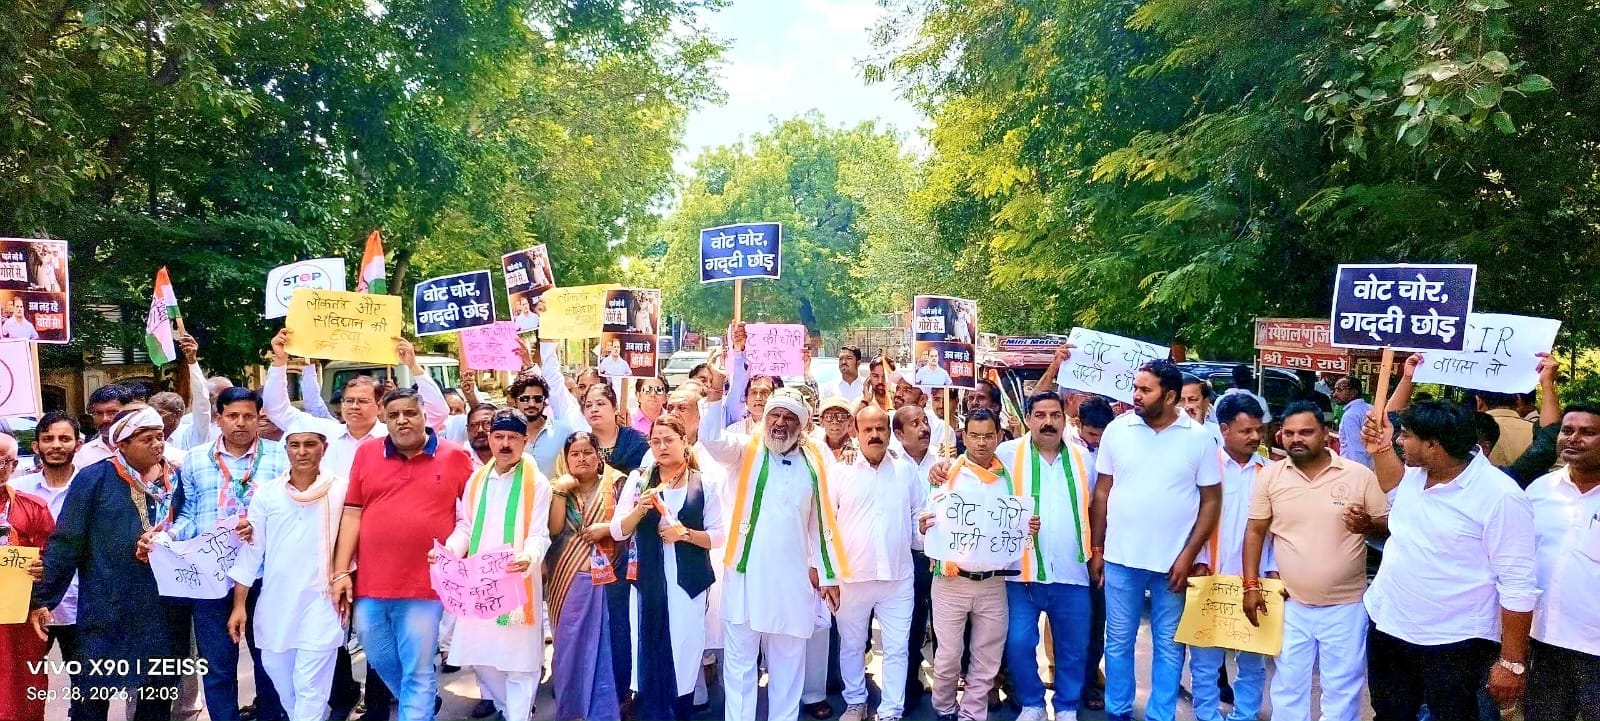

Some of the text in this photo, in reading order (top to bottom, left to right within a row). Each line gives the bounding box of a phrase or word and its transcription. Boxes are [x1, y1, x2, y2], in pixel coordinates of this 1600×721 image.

[711, 229, 768, 249] वोट चोर,
[747, 249, 775, 271] छोड़
[283, 272, 322, 286] STOP
[1353, 273, 1449, 304] वोट चोर,
[423, 280, 480, 302] वोट चोर,
[461, 300, 490, 321] छोड़
[1411, 307, 1460, 343] छोड़
[1084, 333, 1120, 364] वोट
[1466, 323, 1514, 358] IR
[1264, 350, 1348, 371] श्री राधे राधे
[946, 492, 982, 526] वोट
